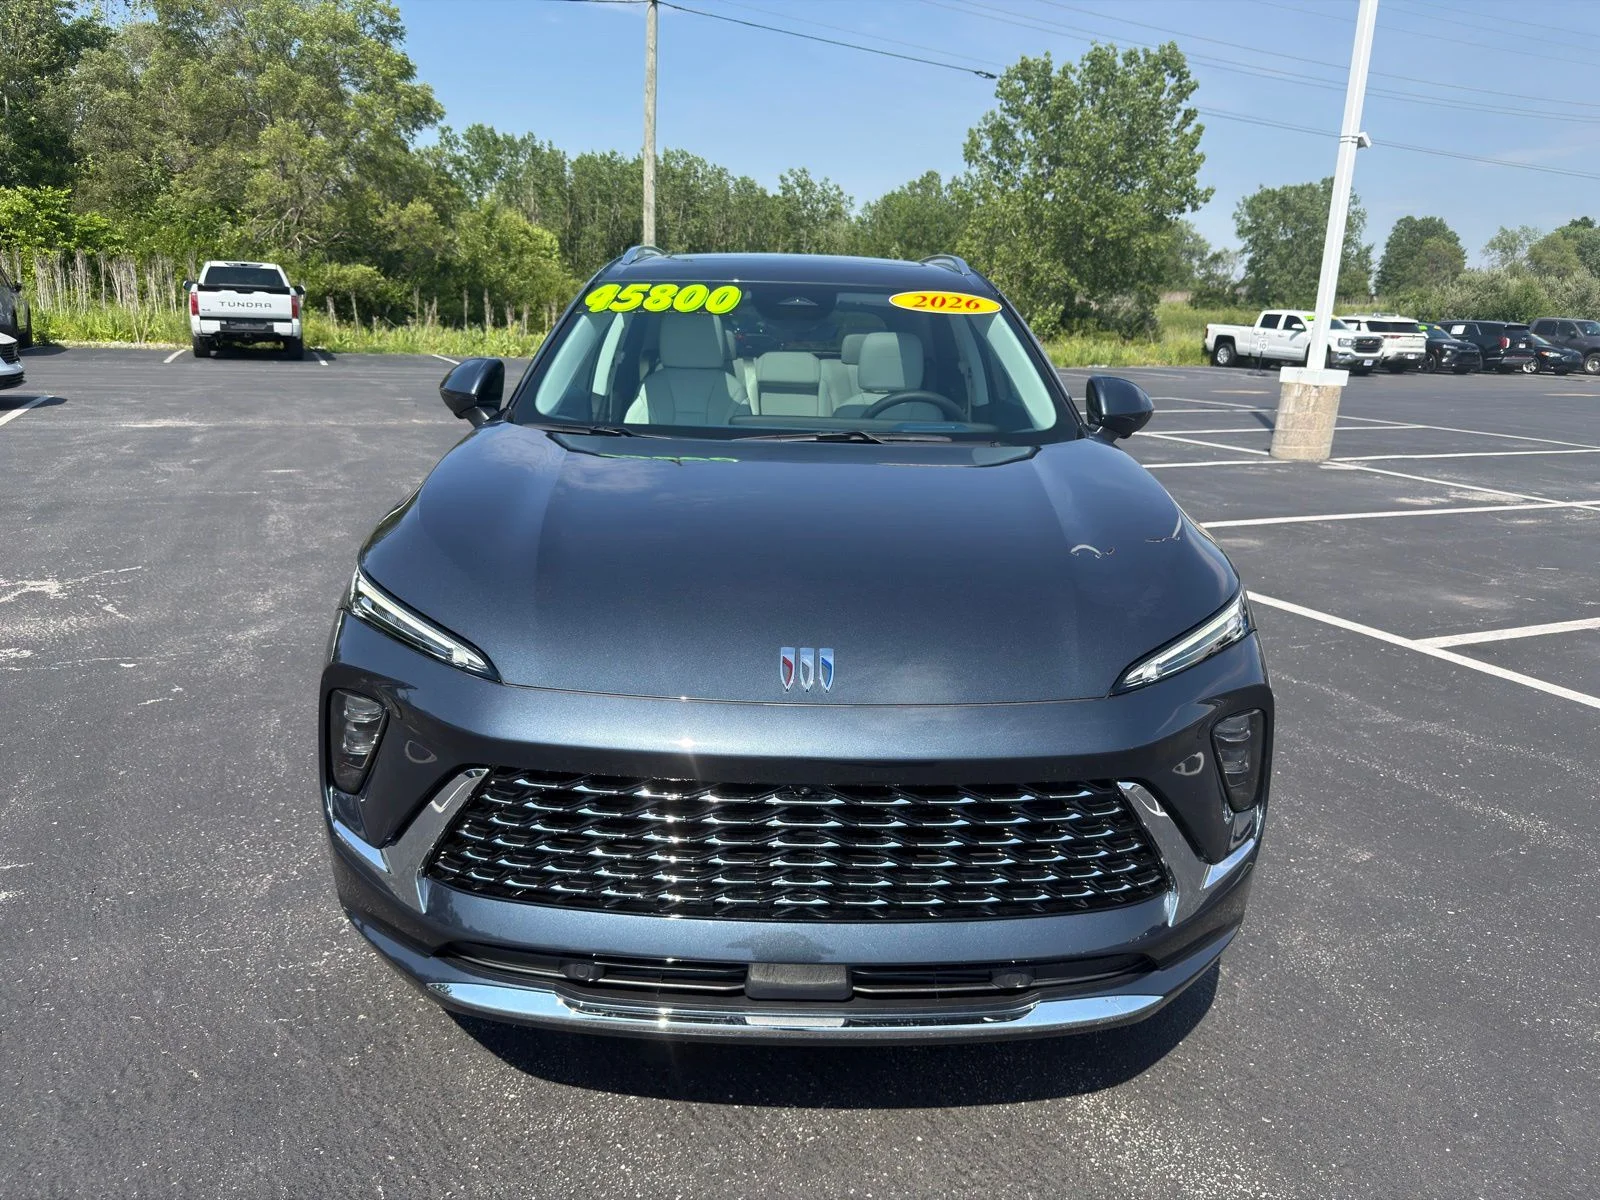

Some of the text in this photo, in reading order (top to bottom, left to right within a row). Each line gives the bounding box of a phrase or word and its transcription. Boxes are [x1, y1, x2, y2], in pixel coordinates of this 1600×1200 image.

[219, 301, 272, 309] TUNDRA
[584, 283, 742, 314] 45800
[912, 295, 980, 310] 2026
